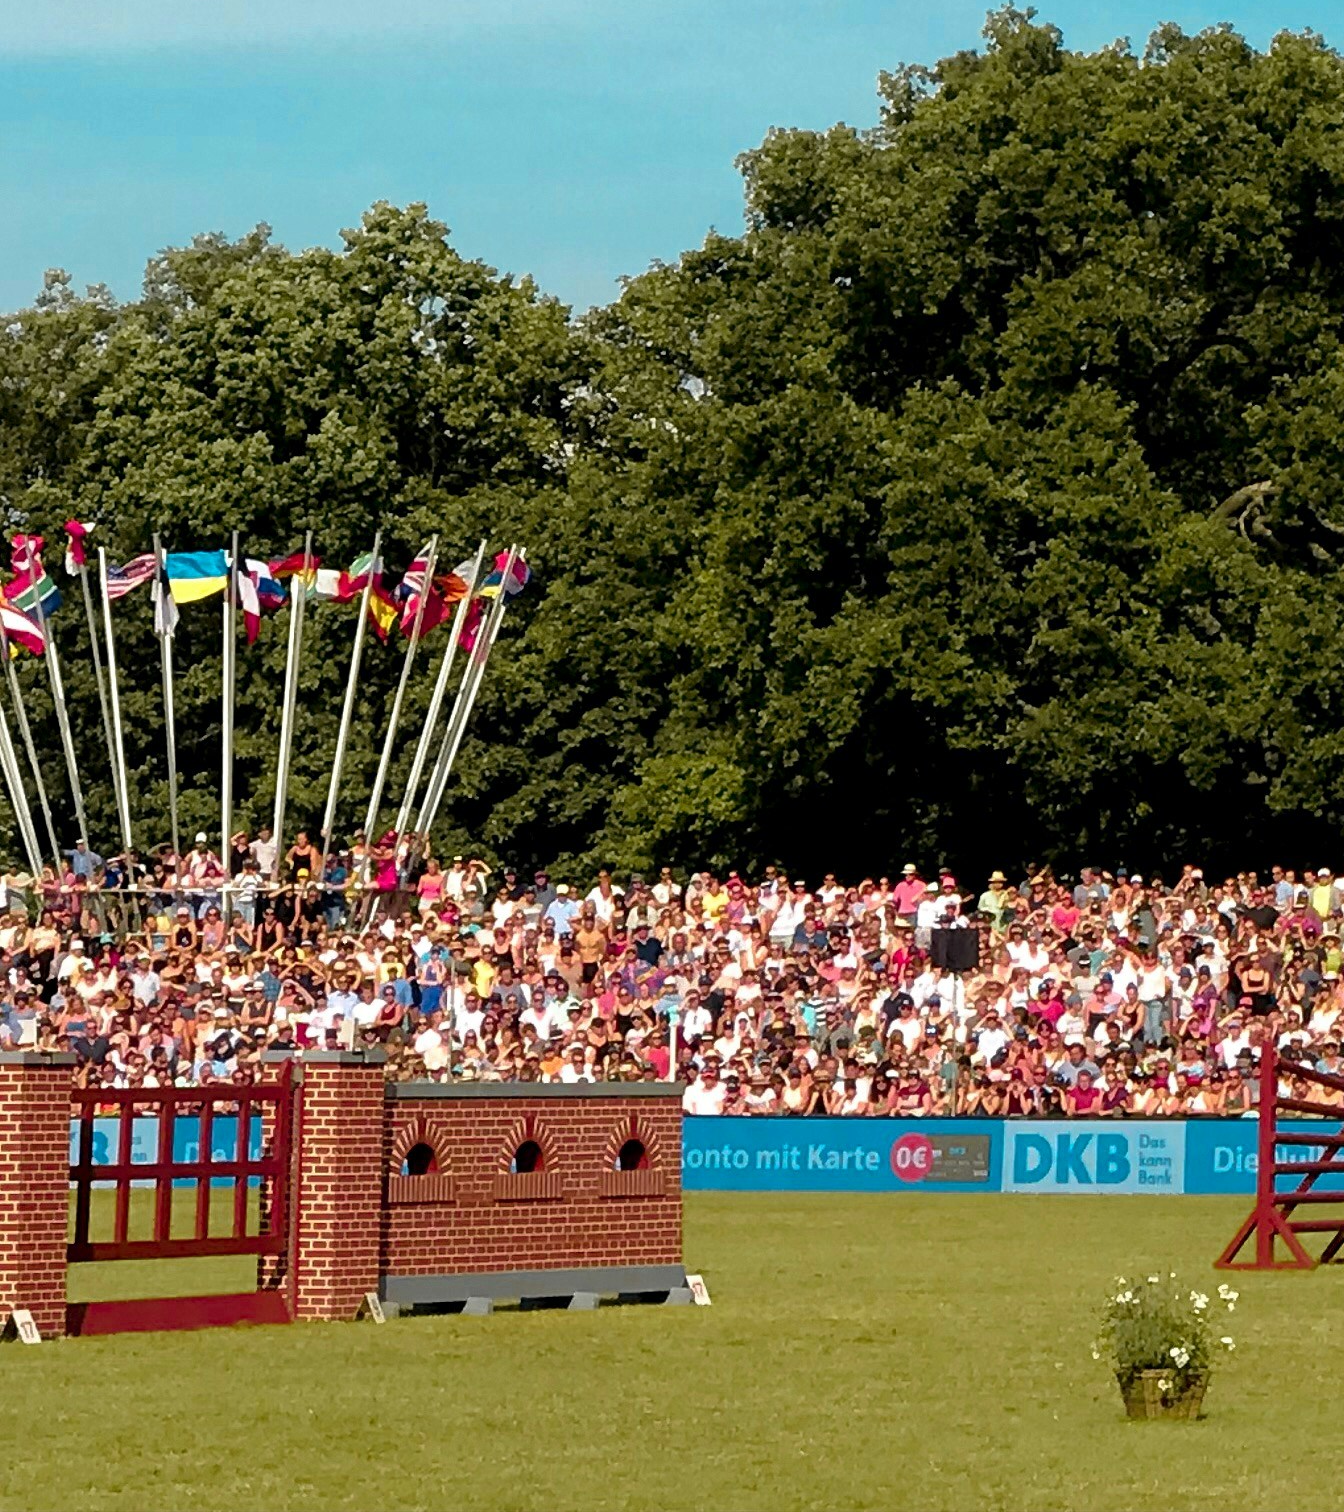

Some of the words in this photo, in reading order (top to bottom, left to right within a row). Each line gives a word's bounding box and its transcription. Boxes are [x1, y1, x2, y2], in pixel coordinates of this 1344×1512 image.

[1138, 1134, 1166, 1149] Das
[755, 1143, 800, 1170] mit
[807, 1143, 881, 1171] Karte
[896, 1146, 927, 1169] 0€
[1014, 1133, 1131, 1184] DKB
[1138, 1152, 1172, 1167] kann
[1213, 1145, 1259, 1173] Die
[1138, 1170, 1172, 1185] Bank
